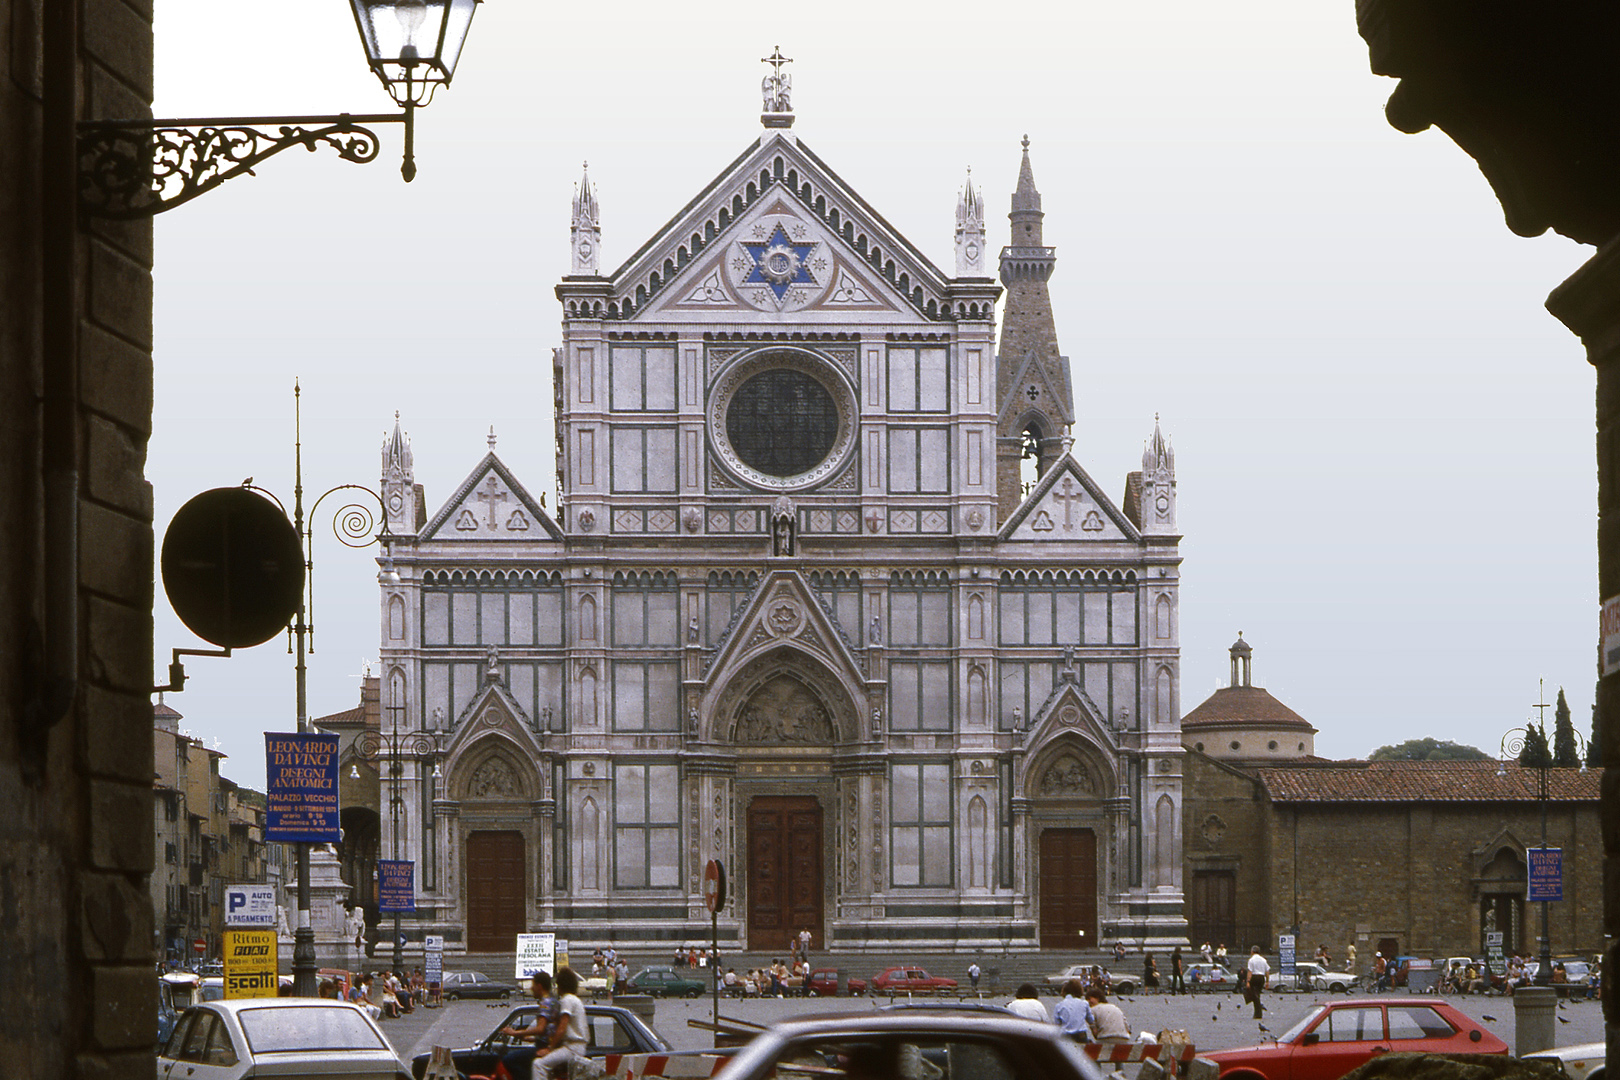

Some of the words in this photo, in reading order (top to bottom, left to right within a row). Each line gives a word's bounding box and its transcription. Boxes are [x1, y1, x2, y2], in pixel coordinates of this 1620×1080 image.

[268, 741, 337, 754] LEONARDO
[274, 754, 292, 765] DA
[295, 754, 330, 766] VINCI
[280, 768, 326, 778] DISEGNI
[272, 778, 332, 788] ANATOMICI
[304, 794, 336, 802] VECCHIO
[229, 892, 246, 912] P
[233, 934, 270, 944] Ritmo
[234, 946, 269, 956] FIAT
[229, 971, 274, 988] scotti
